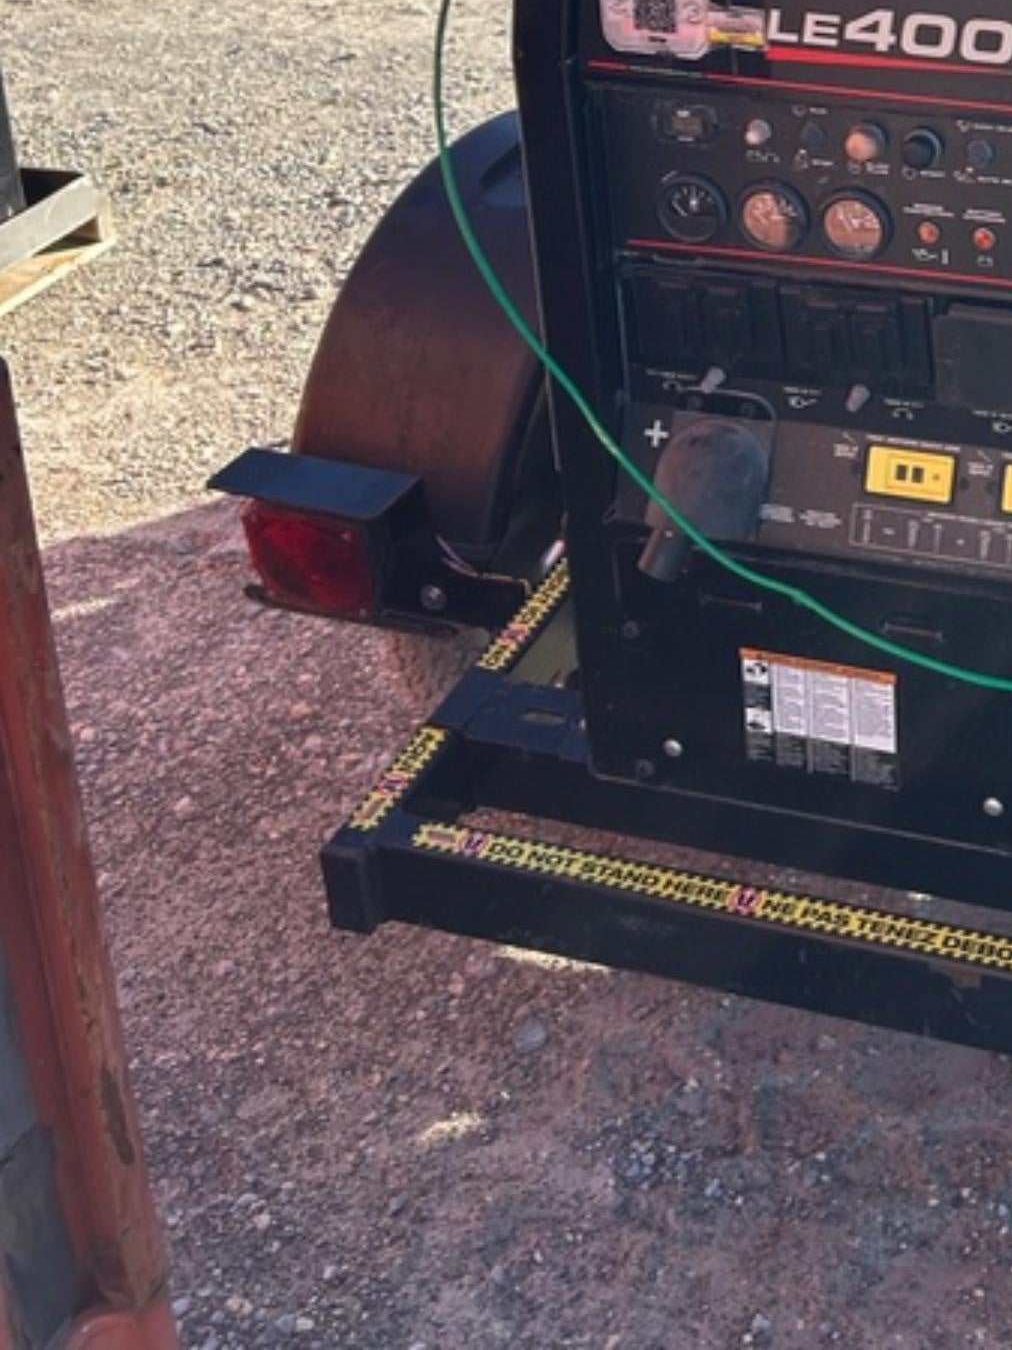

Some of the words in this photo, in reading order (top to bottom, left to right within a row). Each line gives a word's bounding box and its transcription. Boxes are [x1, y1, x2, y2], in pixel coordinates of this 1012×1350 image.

[488, 840, 523, 859] DO
[528, 849, 573, 870] NOT
[581, 860, 658, 887] STAND
[663, 876, 729, 902] HERE
[761, 896, 800, 917] NE
[800, 905, 851, 928] PAS
[857, 916, 940, 946] TENEZ
